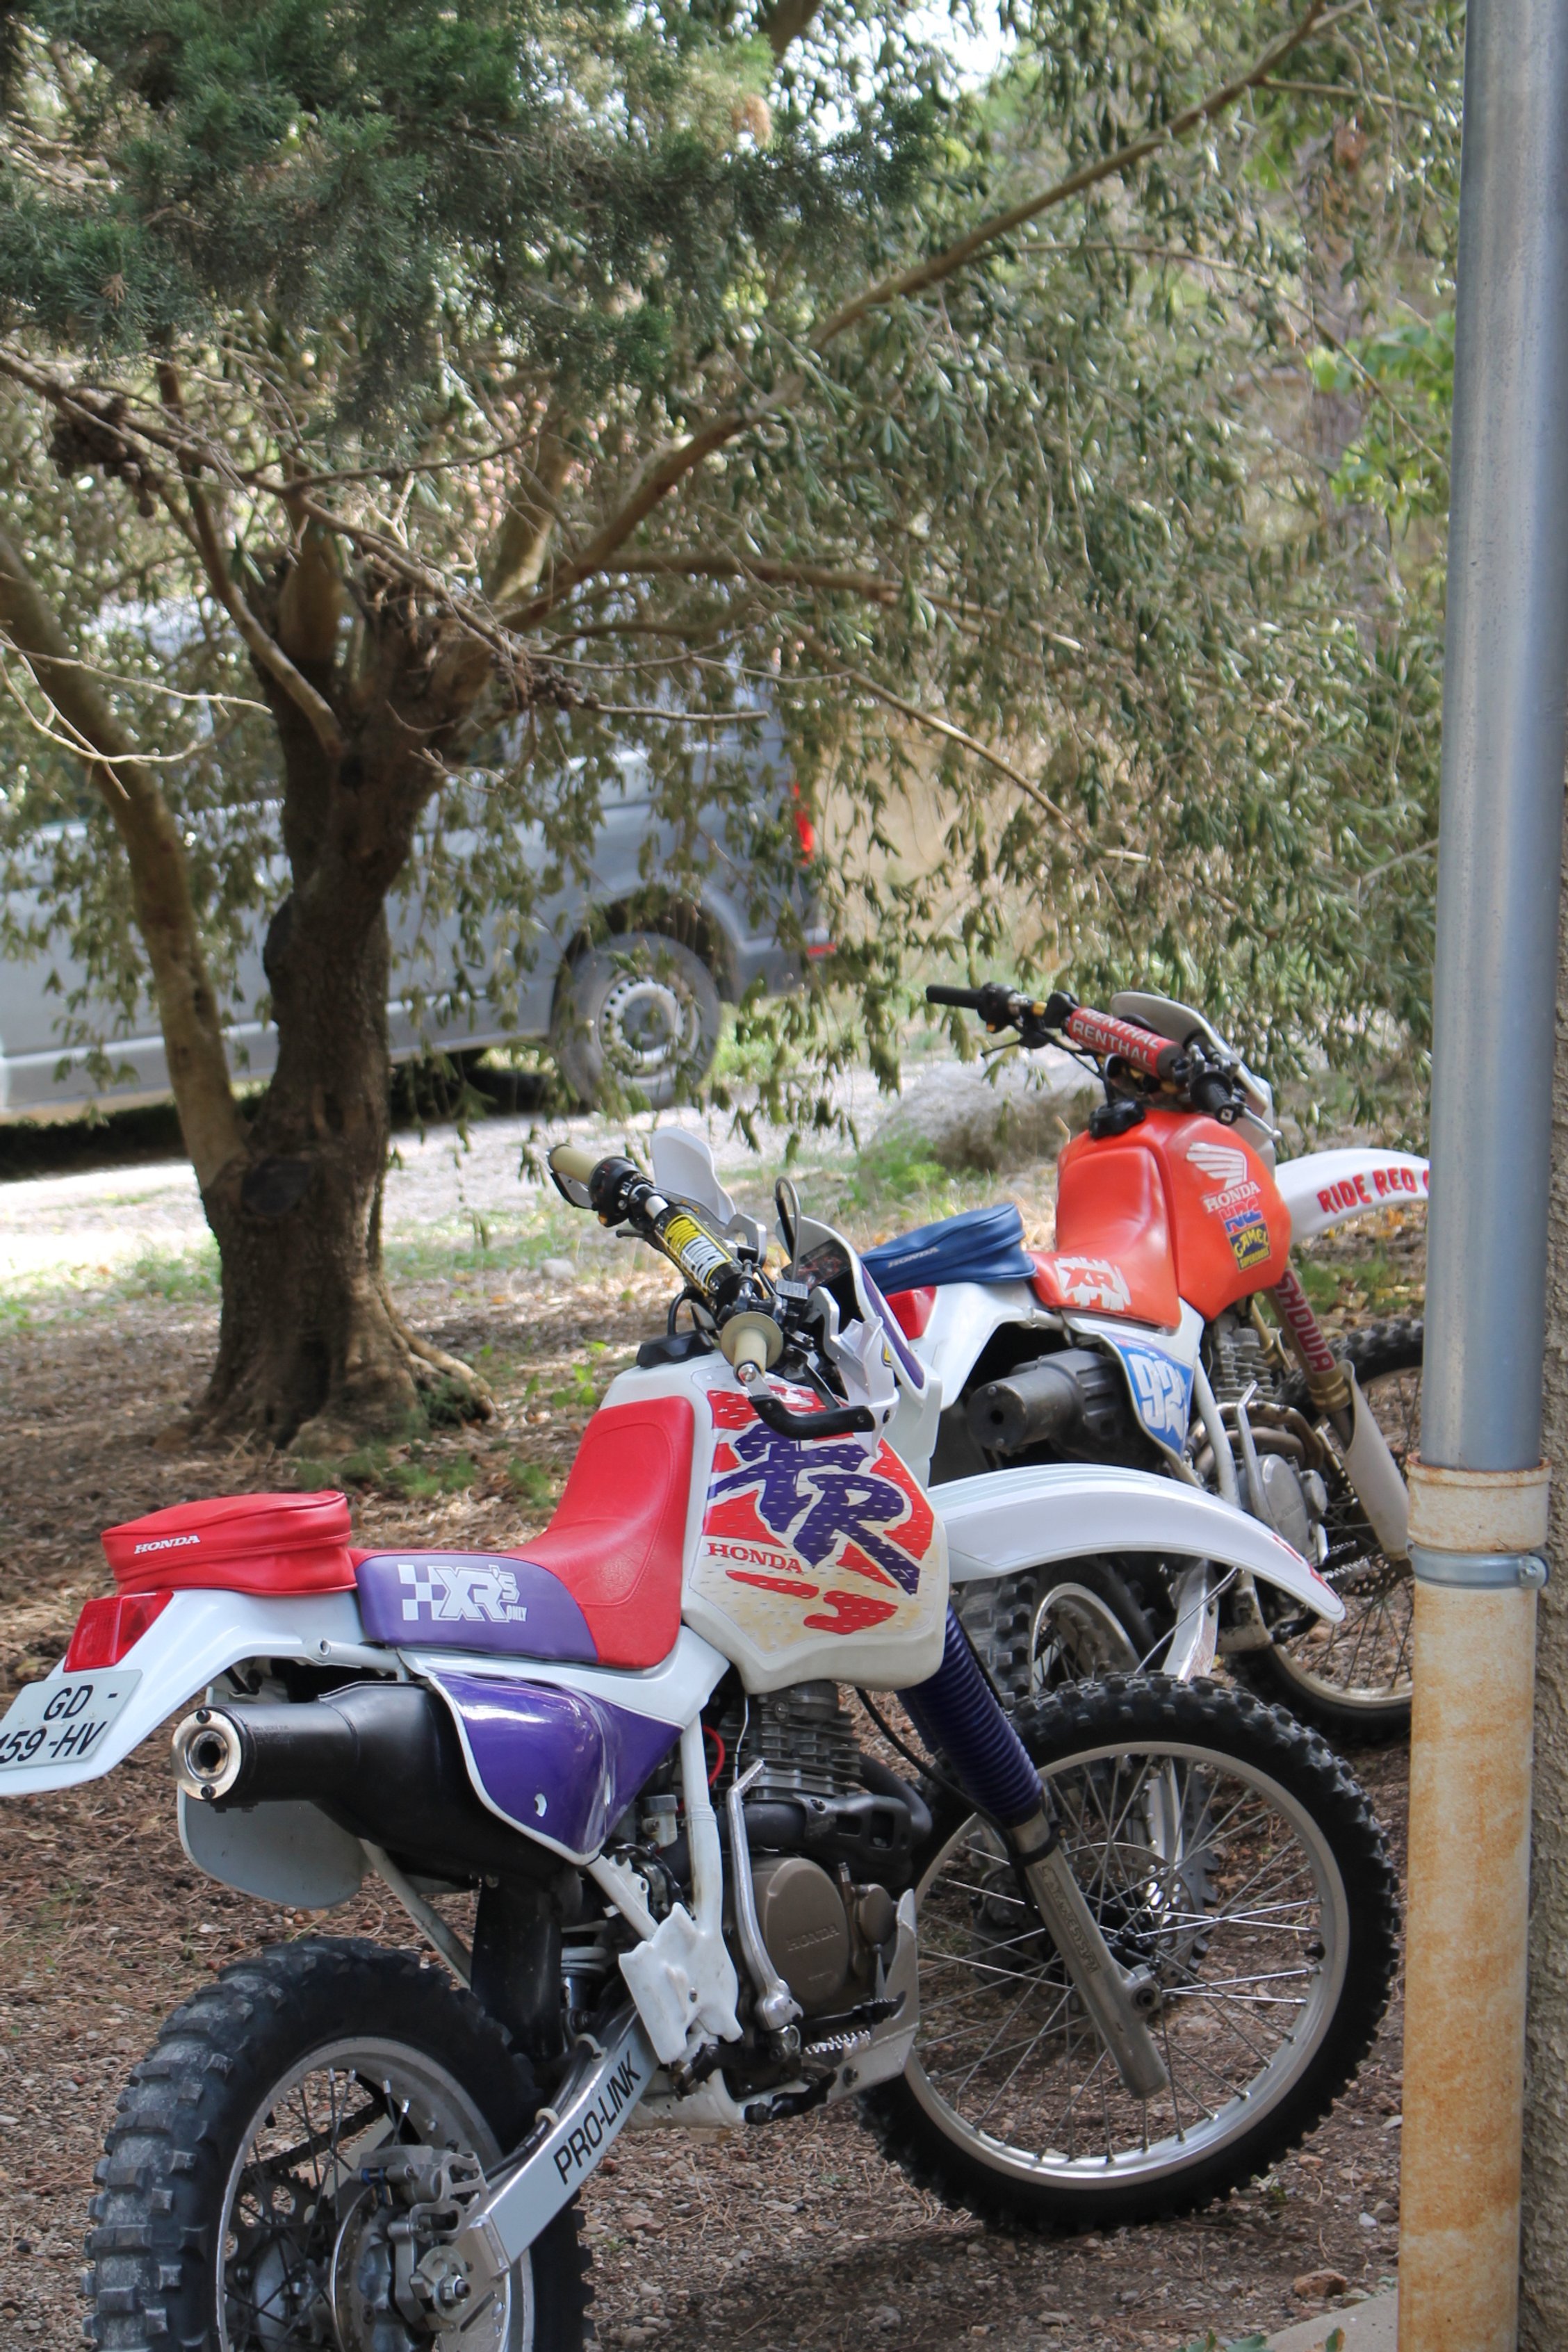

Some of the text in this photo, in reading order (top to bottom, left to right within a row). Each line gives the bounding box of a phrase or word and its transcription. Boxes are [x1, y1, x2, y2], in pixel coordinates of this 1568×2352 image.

[1072, 1020, 1152, 1067] RENTHAL
[1081, 1008, 1159, 1049] RENTHAL
[1204, 1181, 1261, 1213] HONDA
[1317, 1174, 1372, 1214] RIDE
[1372, 1168, 1418, 1197] RED
[1233, 1227, 1269, 1258] CAMEL
[134, 1535, 200, 1554] HONDA
[708, 1542, 804, 1575] HONDA
[505, 1604, 528, 1622] ONLY
[553, 2050, 642, 2185] PRO-LINK
